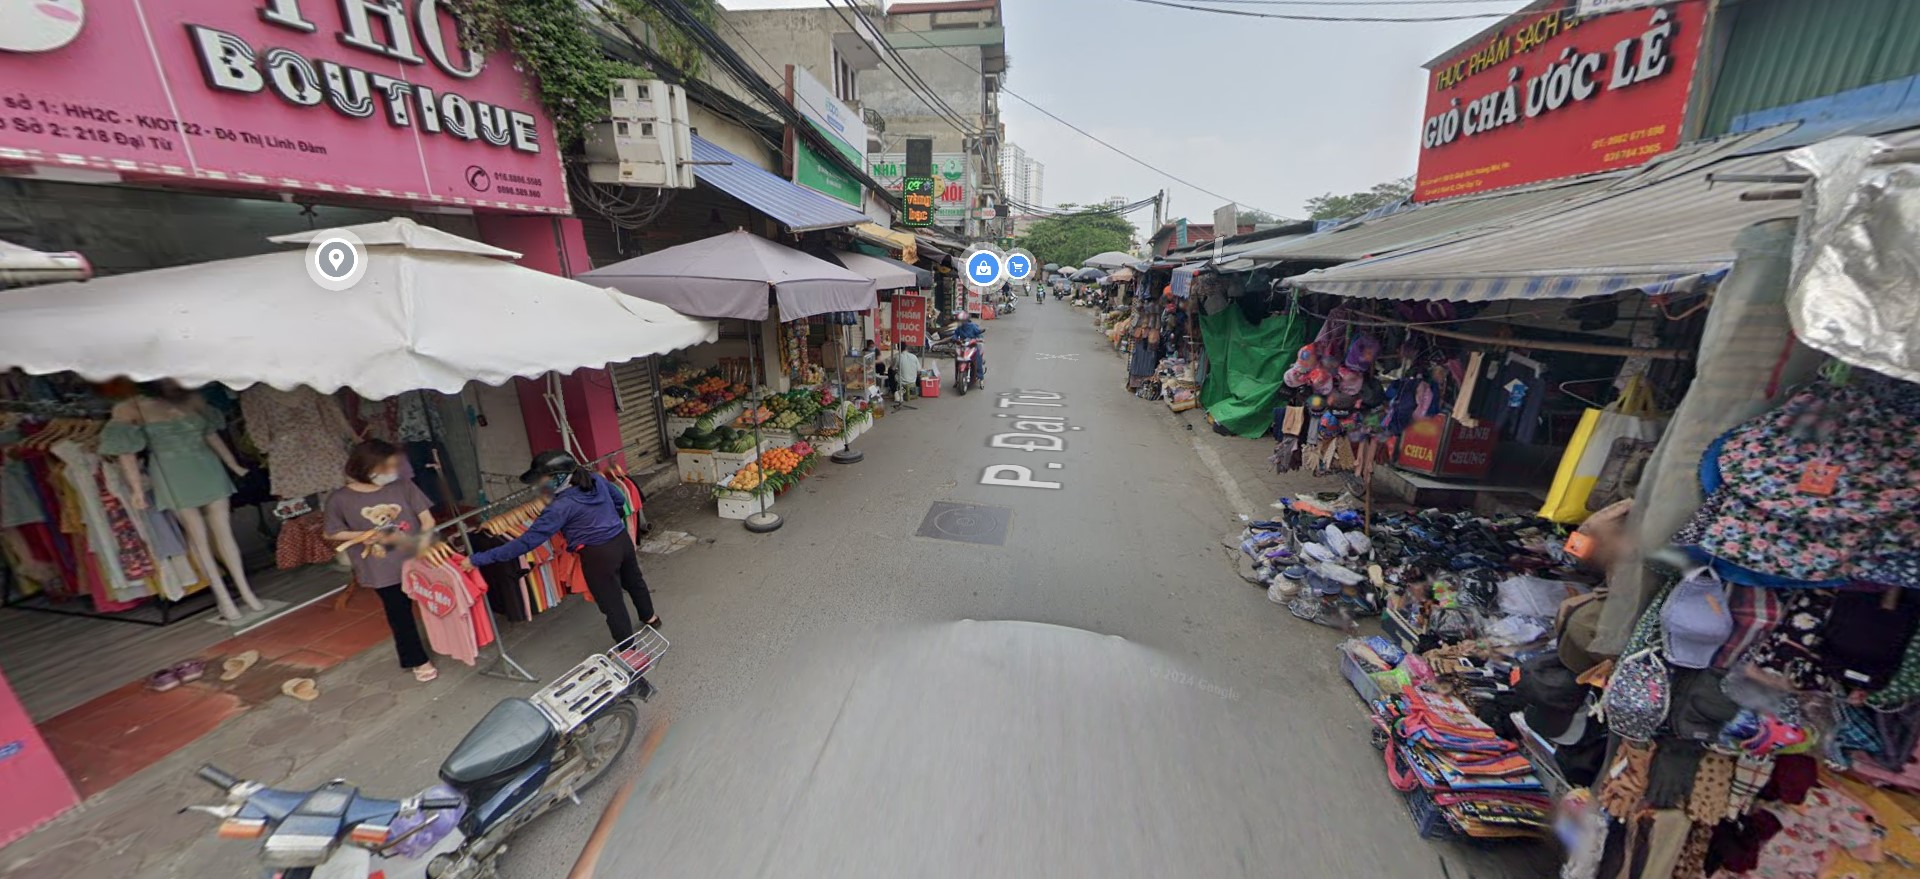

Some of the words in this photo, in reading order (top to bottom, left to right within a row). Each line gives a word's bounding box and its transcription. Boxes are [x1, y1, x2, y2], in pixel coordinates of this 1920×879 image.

[187, 24, 541, 154] BOUTIQUE
[1423, 97, 1461, 149] GIÒ
[1463, 66, 1518, 136] CHẢ
[1525, 47, 1601, 118] ƯỚC
[63, 102, 121, 125] HH2C
[136, 114, 179, 133] KIOT
[182, 121, 202, 136] 22
[265, 136, 297, 151] Linh
[906, 193, 931, 207] vàng
[908, 207, 928, 222] bạc
[1404, 443, 1434, 462] CHUA
